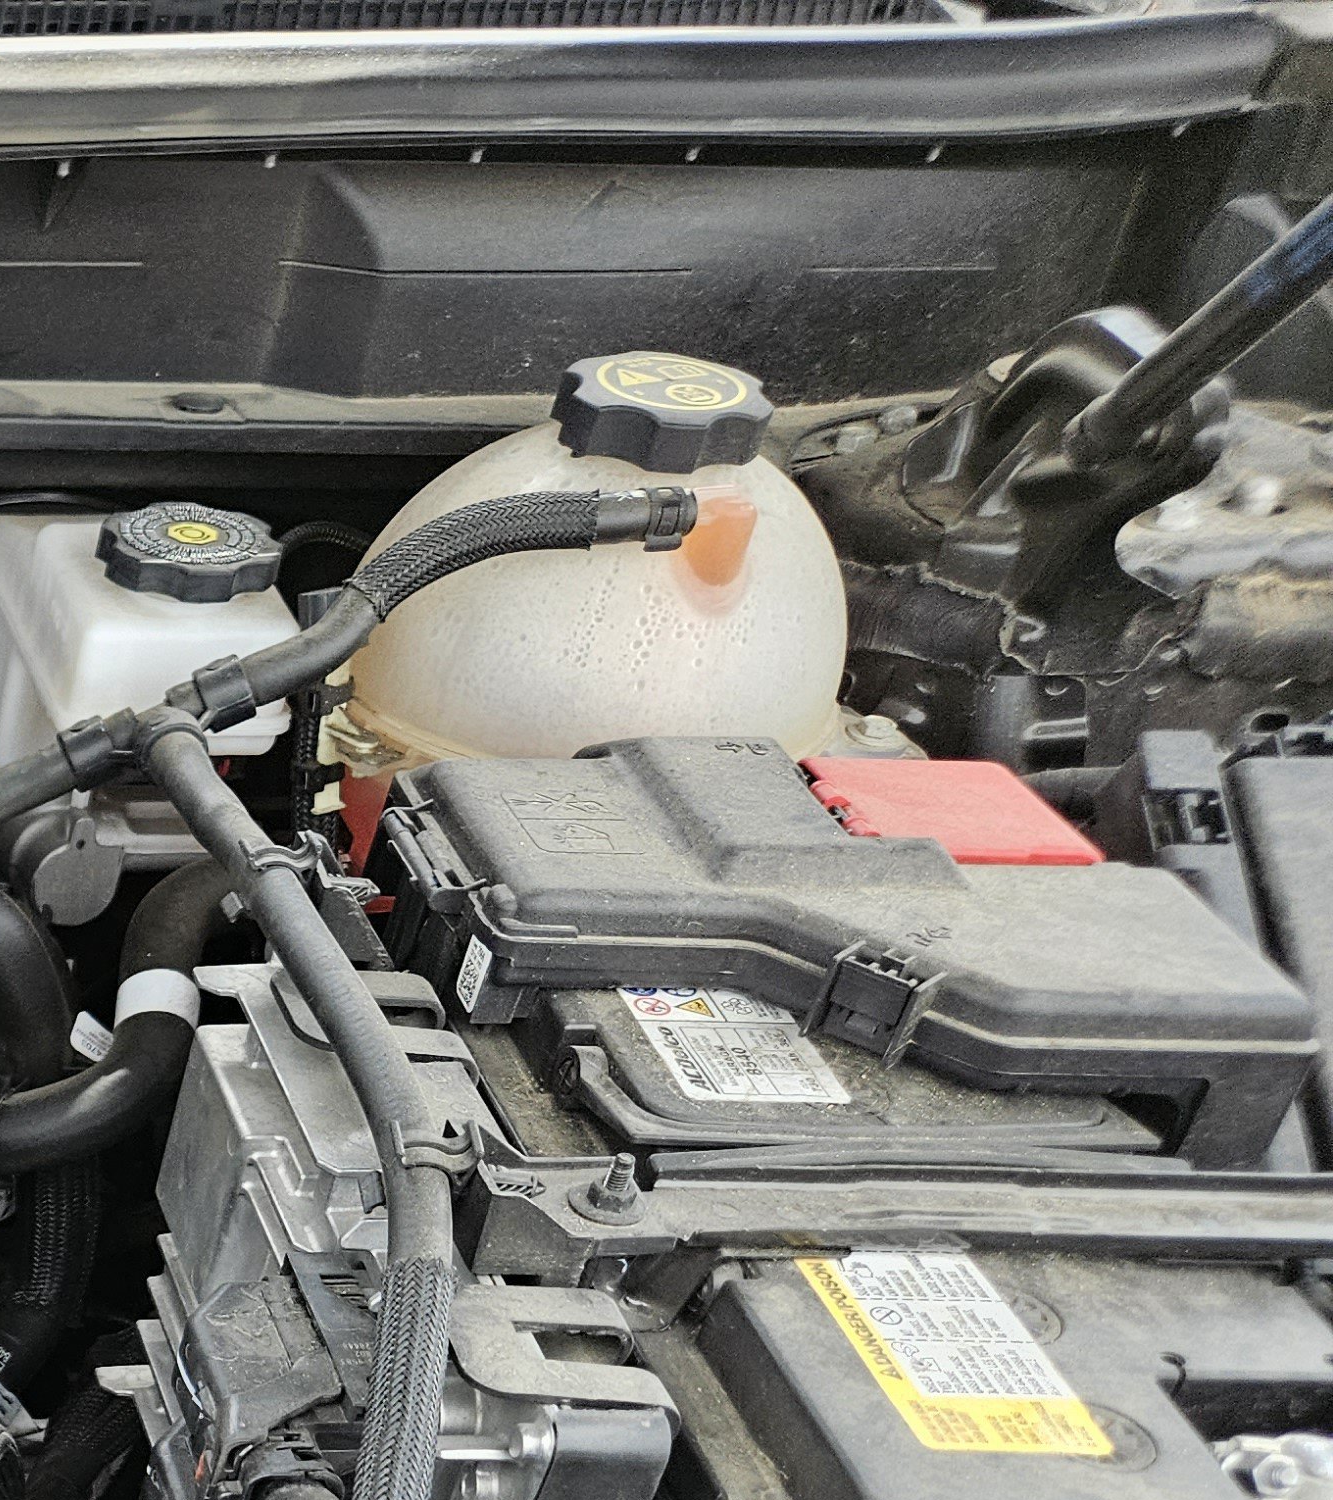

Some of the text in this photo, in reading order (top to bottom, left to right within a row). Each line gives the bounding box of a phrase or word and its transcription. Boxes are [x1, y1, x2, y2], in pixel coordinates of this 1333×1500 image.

[657, 1026, 711, 1091] ACDelco
[729, 1047, 764, 1075] 8540
[807, 1262, 892, 1365] DANGER/POISON
